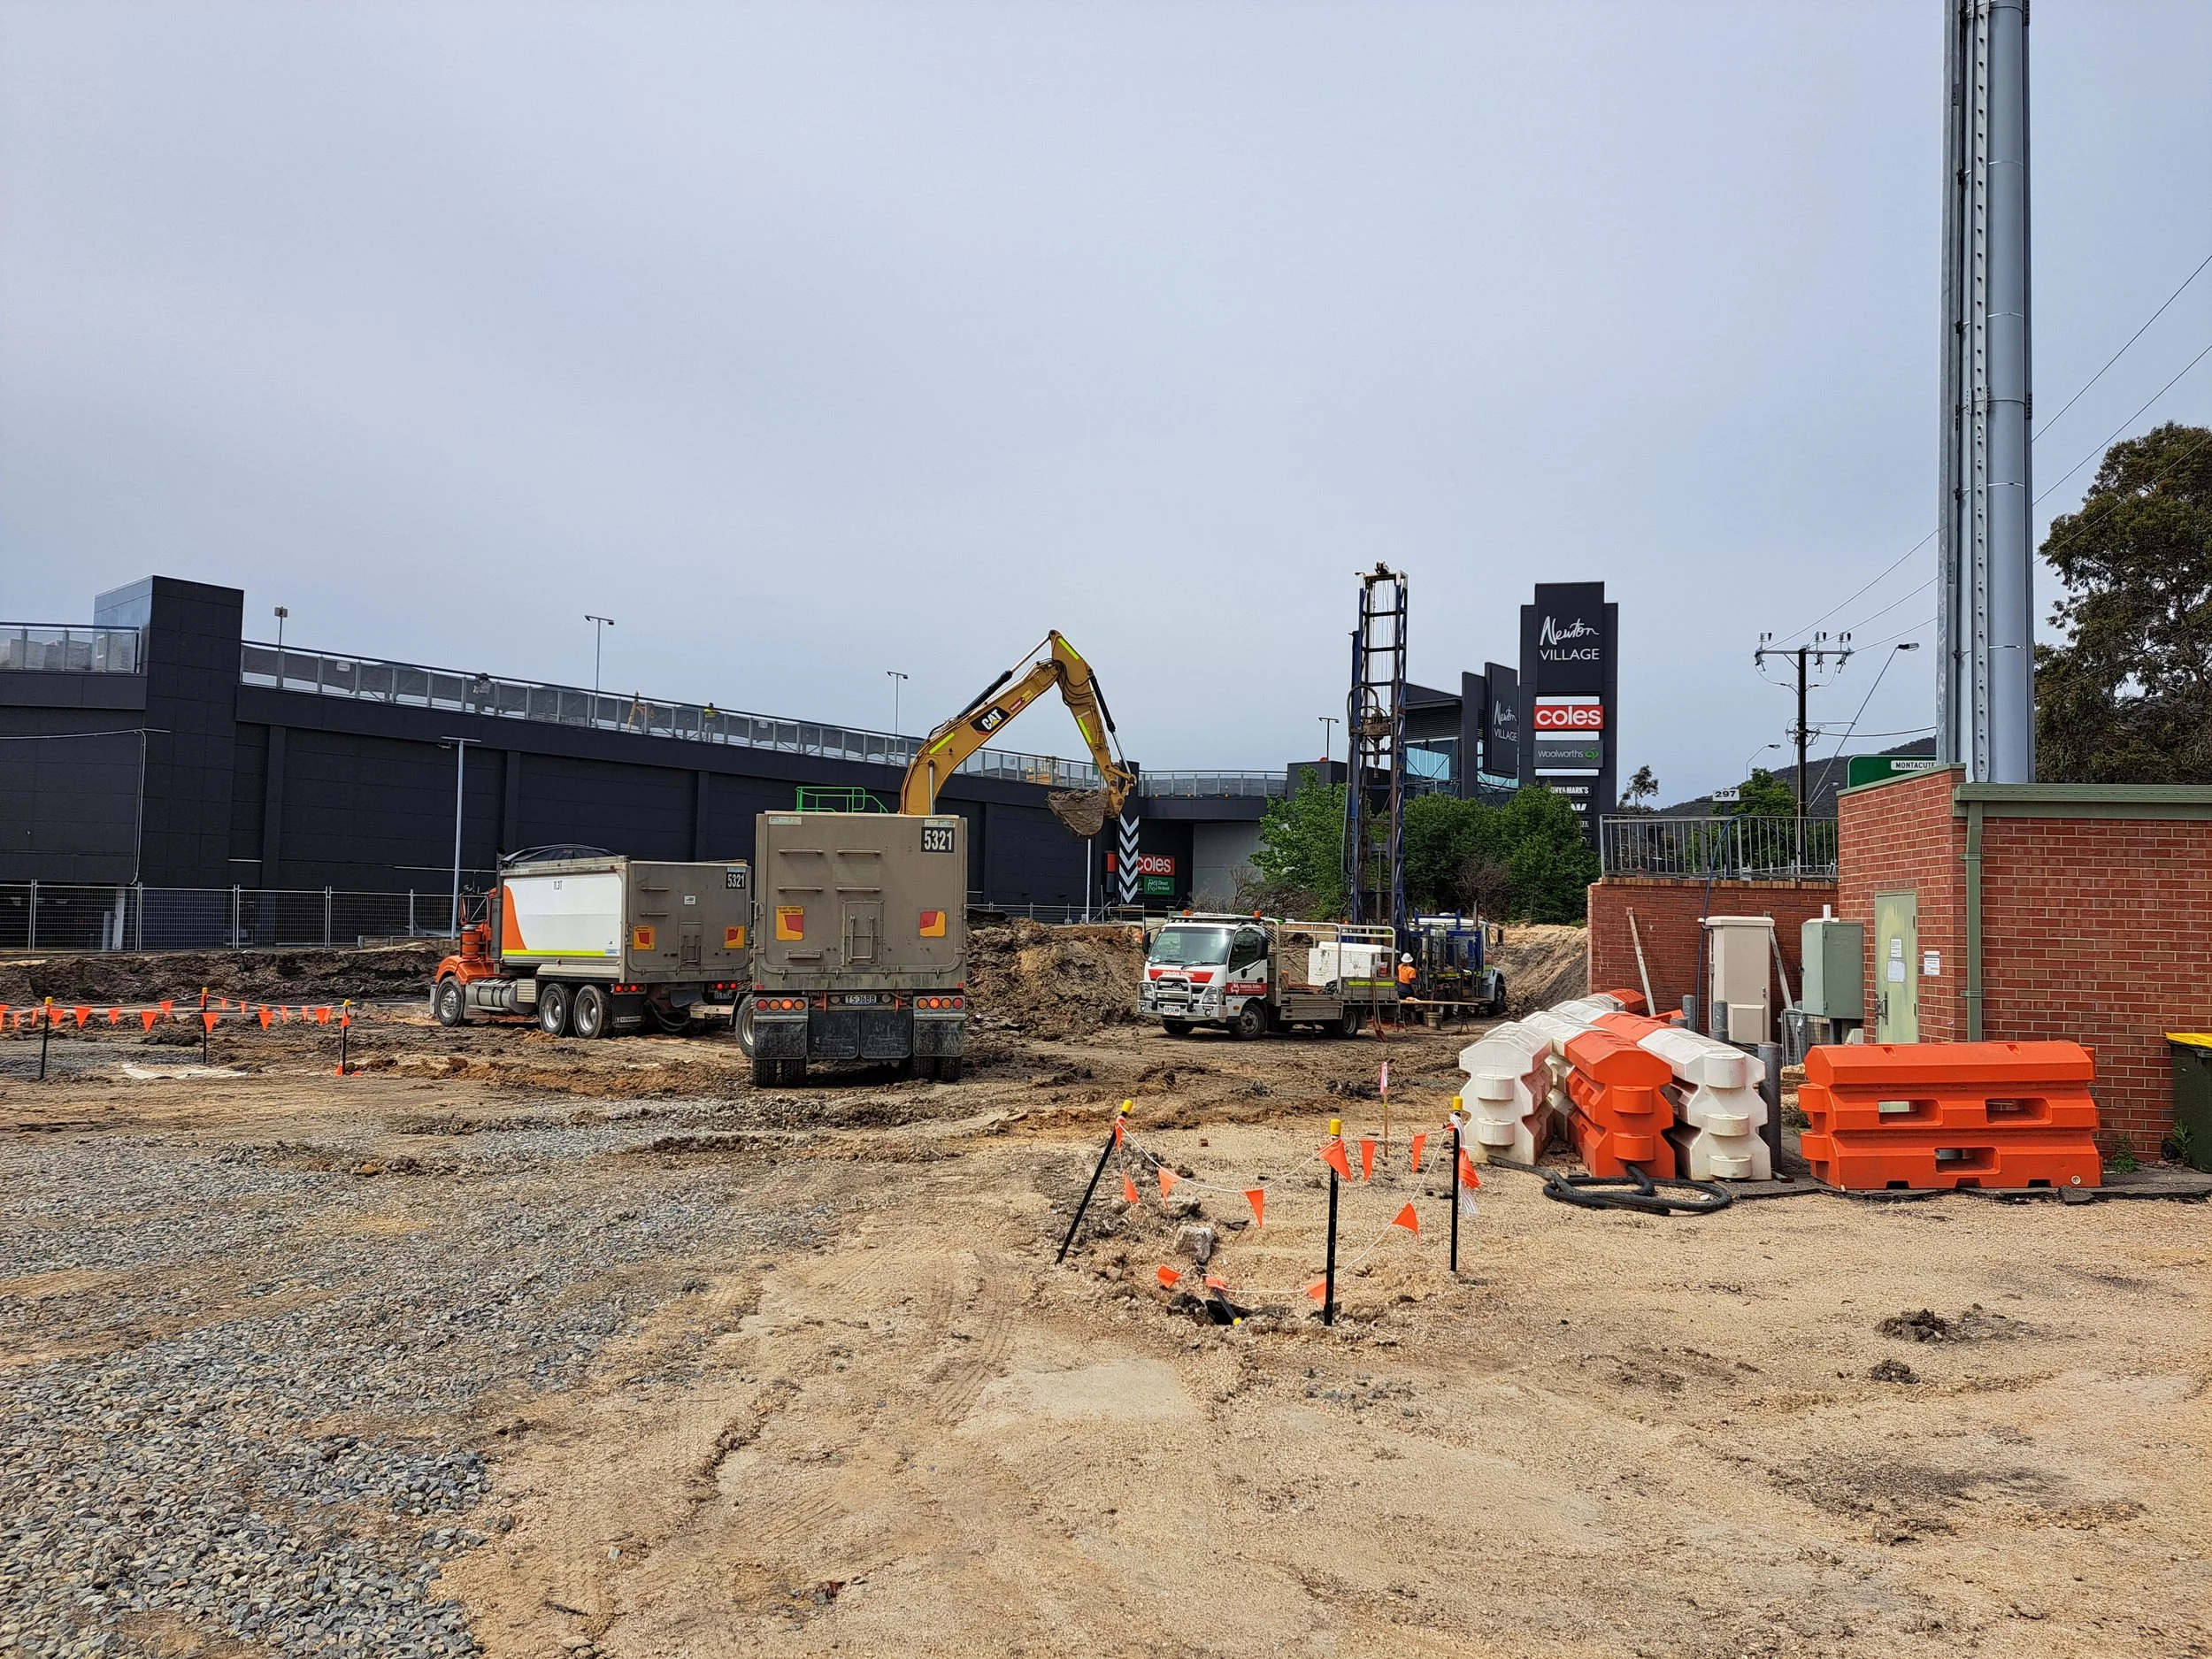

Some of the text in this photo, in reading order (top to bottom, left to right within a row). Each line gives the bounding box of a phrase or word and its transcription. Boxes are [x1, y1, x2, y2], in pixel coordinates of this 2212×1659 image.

[1540, 615, 1600, 646] Newton
[1540, 649, 1600, 660] VILLAGE
[981, 709, 1002, 730] CAT
[1494, 700, 1517, 726] Newton
[1536, 705, 1601, 726] coles
[1494, 727, 1517, 741] VILLAGE
[924, 830, 953, 850] 5321
[1136, 856, 1171, 873] coles
[727, 873, 745, 887] 5321
